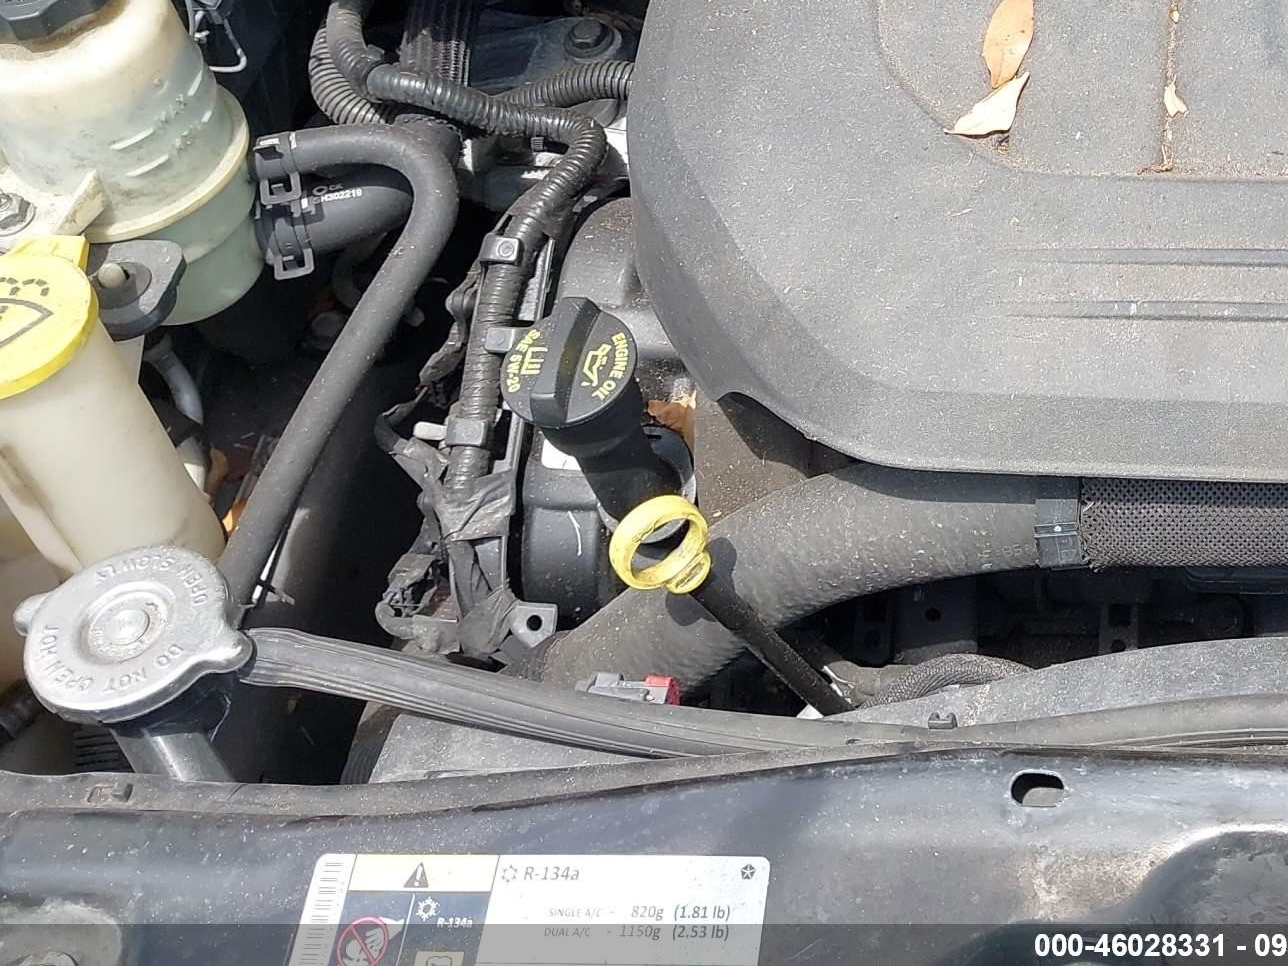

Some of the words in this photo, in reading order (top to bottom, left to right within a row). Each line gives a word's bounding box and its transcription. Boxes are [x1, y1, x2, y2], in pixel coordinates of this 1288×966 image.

[514, 329, 541, 352] SAE
[611, 332, 629, 379] ENGINE
[506, 354, 523, 393] 5W-20
[591, 380, 617, 402] OIL
[40, 625, 60, 659] HOT
[155, 643, 185, 668] DO
[45, 659, 95, 693] OPEN
[103, 666, 148, 693] NOT
[523, 866, 580, 882] R-134a
[436, 916, 473, 929] R-134a
[548, 906, 583, 919] SINGLE
[630, 905, 664, 922] 820g
[674, 904, 708, 922] (1.81
[712, 905, 731, 922] lb)
[544, 926, 569, 938] DUAL
[570, 926, 592, 939] A/C
[619, 924, 661, 941] 1150g
[672, 924, 707, 942] (2.53
[711, 924, 730, 942] lb)
